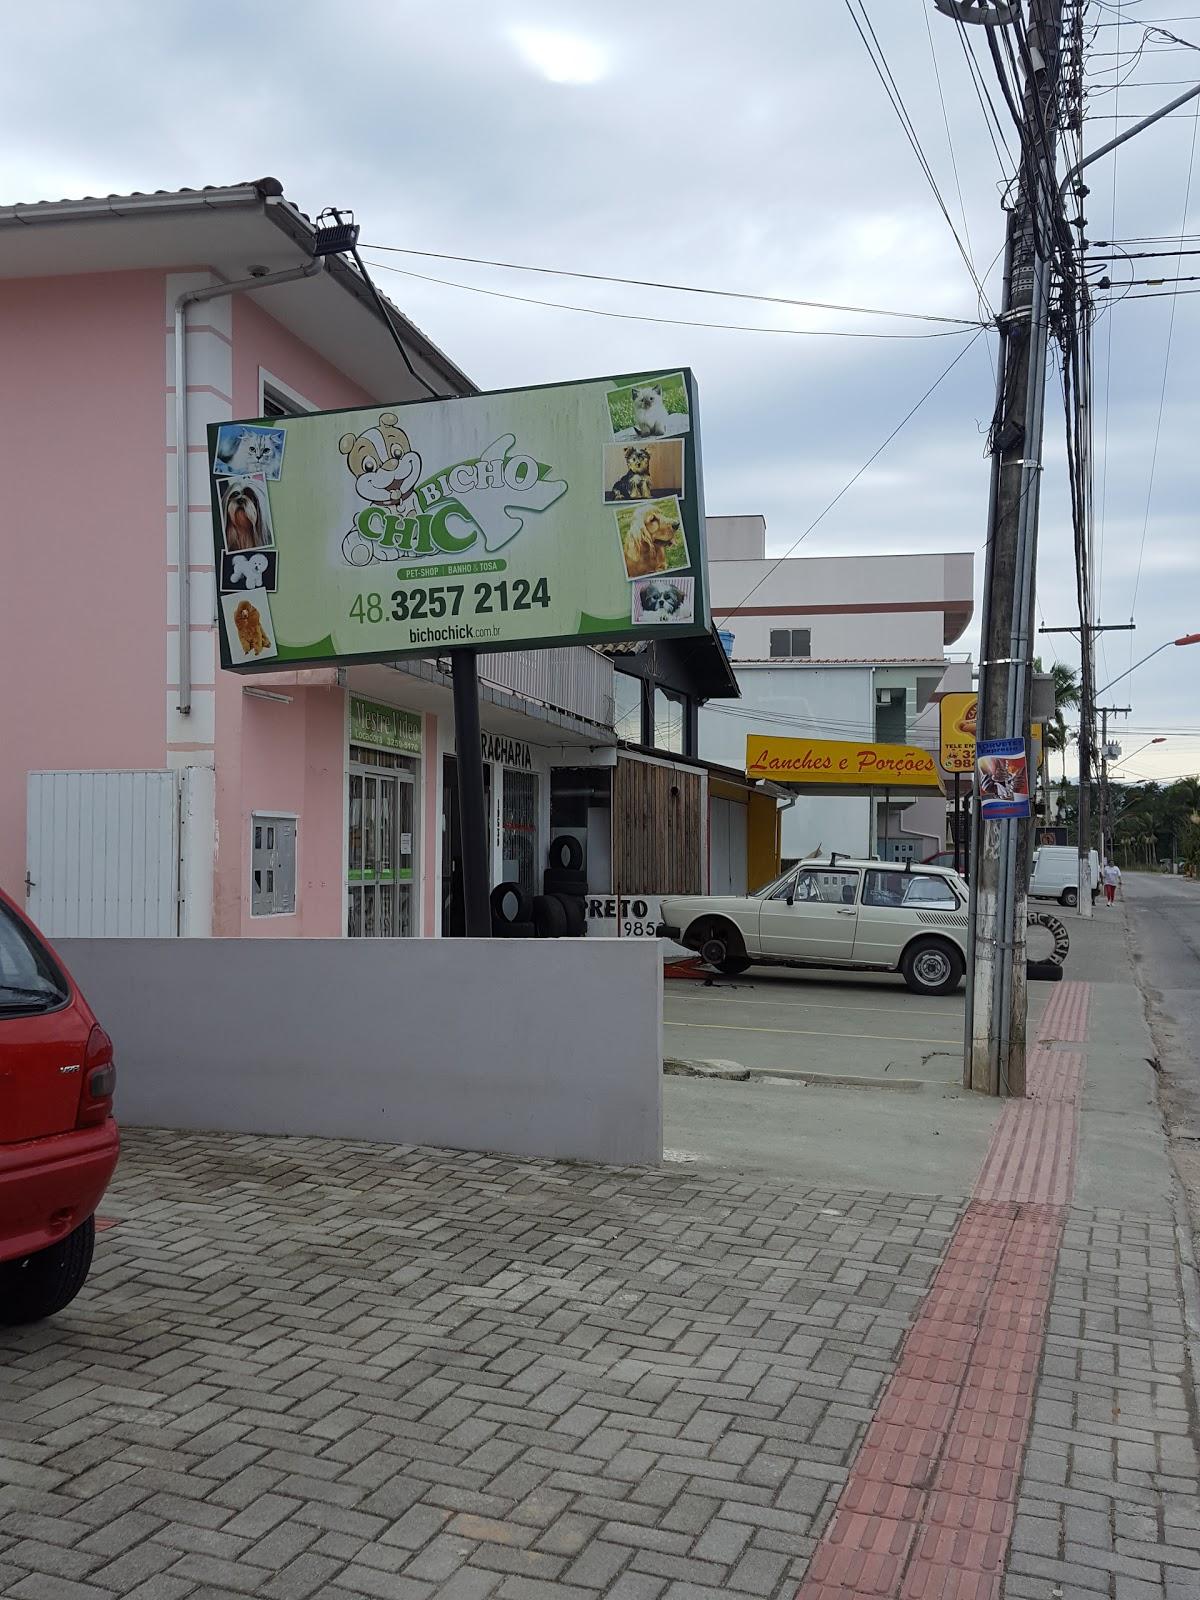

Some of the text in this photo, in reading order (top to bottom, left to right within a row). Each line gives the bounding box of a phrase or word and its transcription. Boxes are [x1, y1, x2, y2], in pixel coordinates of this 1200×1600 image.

[420, 455, 539, 506] BICHO
[358, 502, 478, 554] CHIC
[406, 567, 439, 578] PET-SHOP
[448, 564, 472, 575] BANHO
[480, 562, 498, 571] TOSA
[350, 578, 551, 624] 48.3257 2124
[409, 624, 500, 643] bichochick.com.br
[356, 702, 391, 735] Mestre
[480, 733, 532, 769] RACHARIA
[751, 749, 935, 777] Lanches e Porções
[585, 899, 648, 919] RETO
[624, 921, 664, 937] 985
[1028, 912, 1069, 965] ACHARIA
